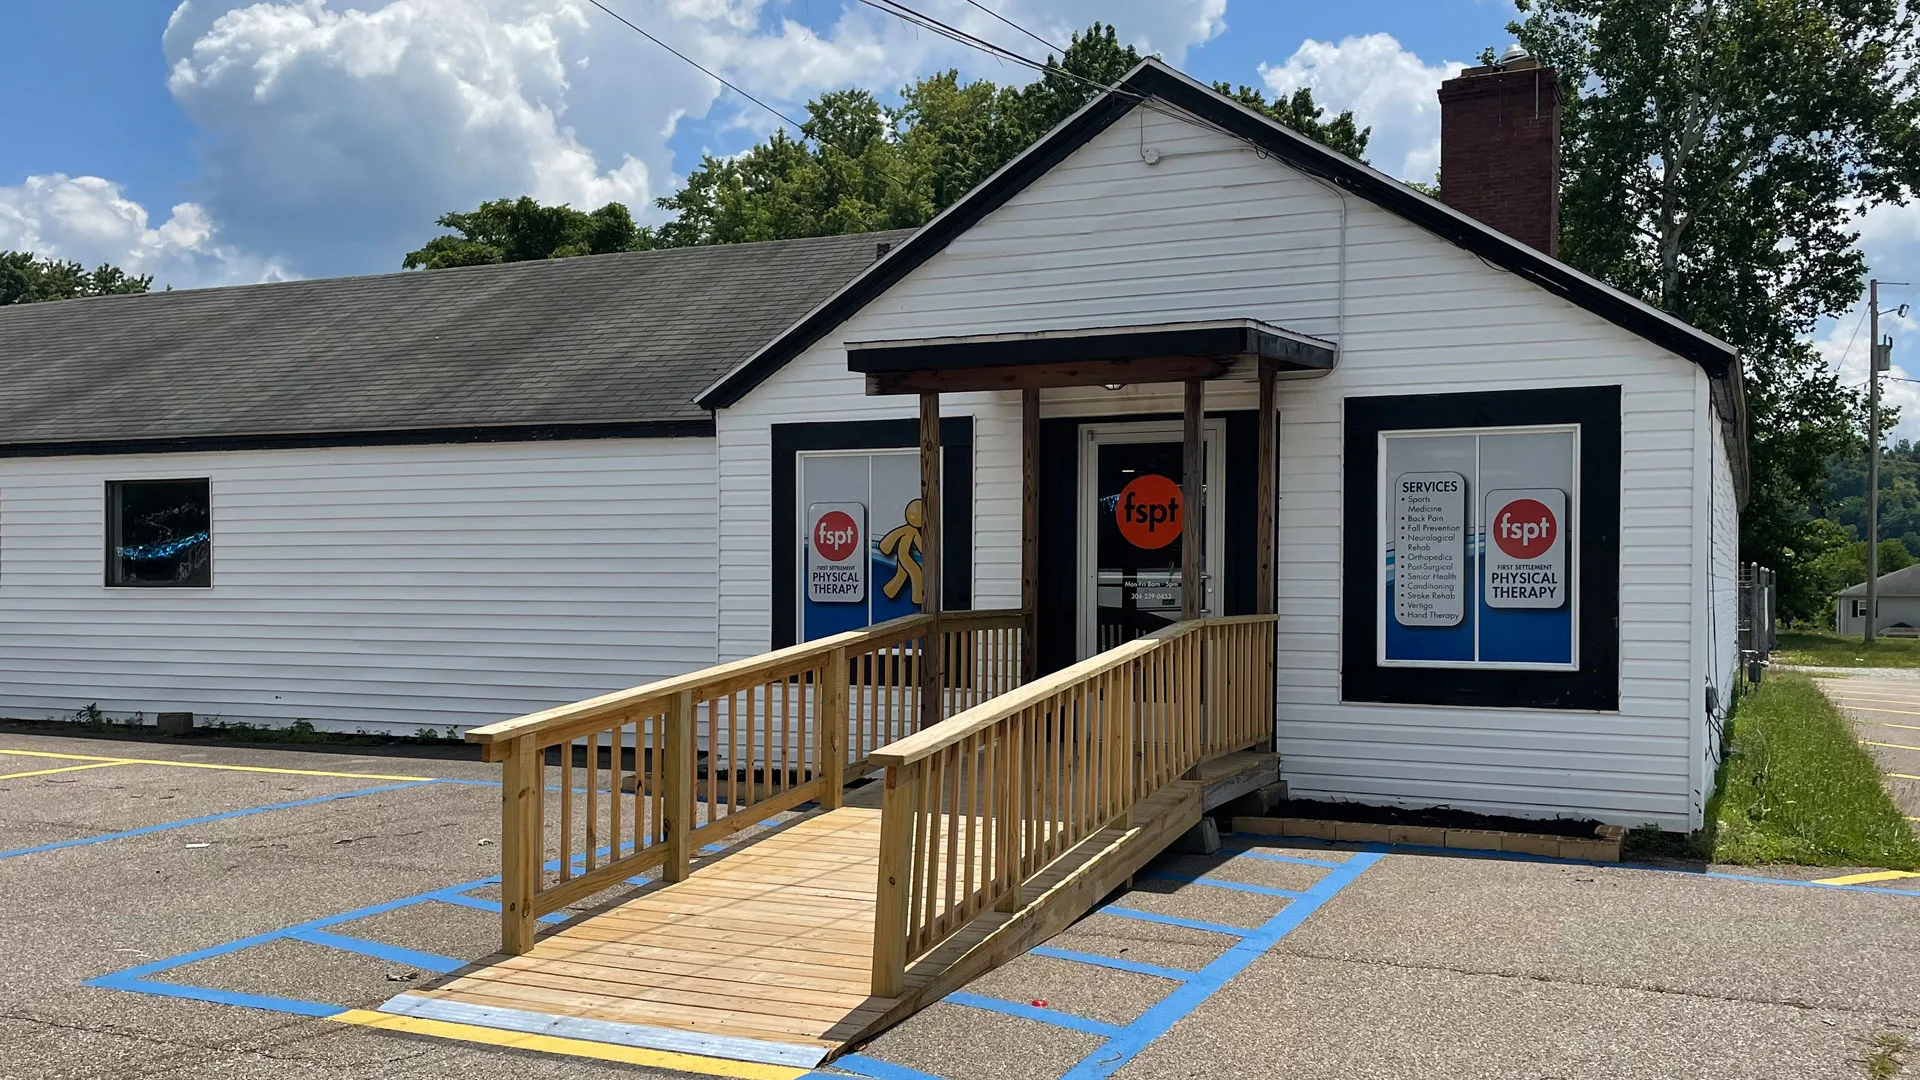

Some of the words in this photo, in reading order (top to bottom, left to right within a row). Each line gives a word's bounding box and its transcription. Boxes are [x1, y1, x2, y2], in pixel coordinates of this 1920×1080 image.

[1402, 481, 1458, 493] SERVICES
[1408, 495, 1431, 504] Sports
[1124, 491, 1179, 533] fspt
[1427, 514, 1444, 522] Pain
[1408, 524, 1421, 532] Fall
[1423, 524, 1460, 532] Prevention
[1500, 512, 1550, 546] fspt
[819, 522, 854, 551] fspt
[1408, 534, 1455, 543] Neurological
[1408, 543, 1431, 551] Rehab
[1407, 553, 1453, 562] Orthopedics
[1407, 563, 1453, 572] Post-Surgical
[812, 572, 859, 582] PHYSICAL
[1433, 572, 1457, 580] Health
[1491, 572, 1558, 584] PHYSICAL
[813, 583, 859, 594] THERAPY
[1407, 582, 1455, 591] Conditioning
[1492, 586, 1557, 598] THERAPY
[1407, 602, 1433, 611] Vertigo
[1430, 611, 1460, 620] Therapy
